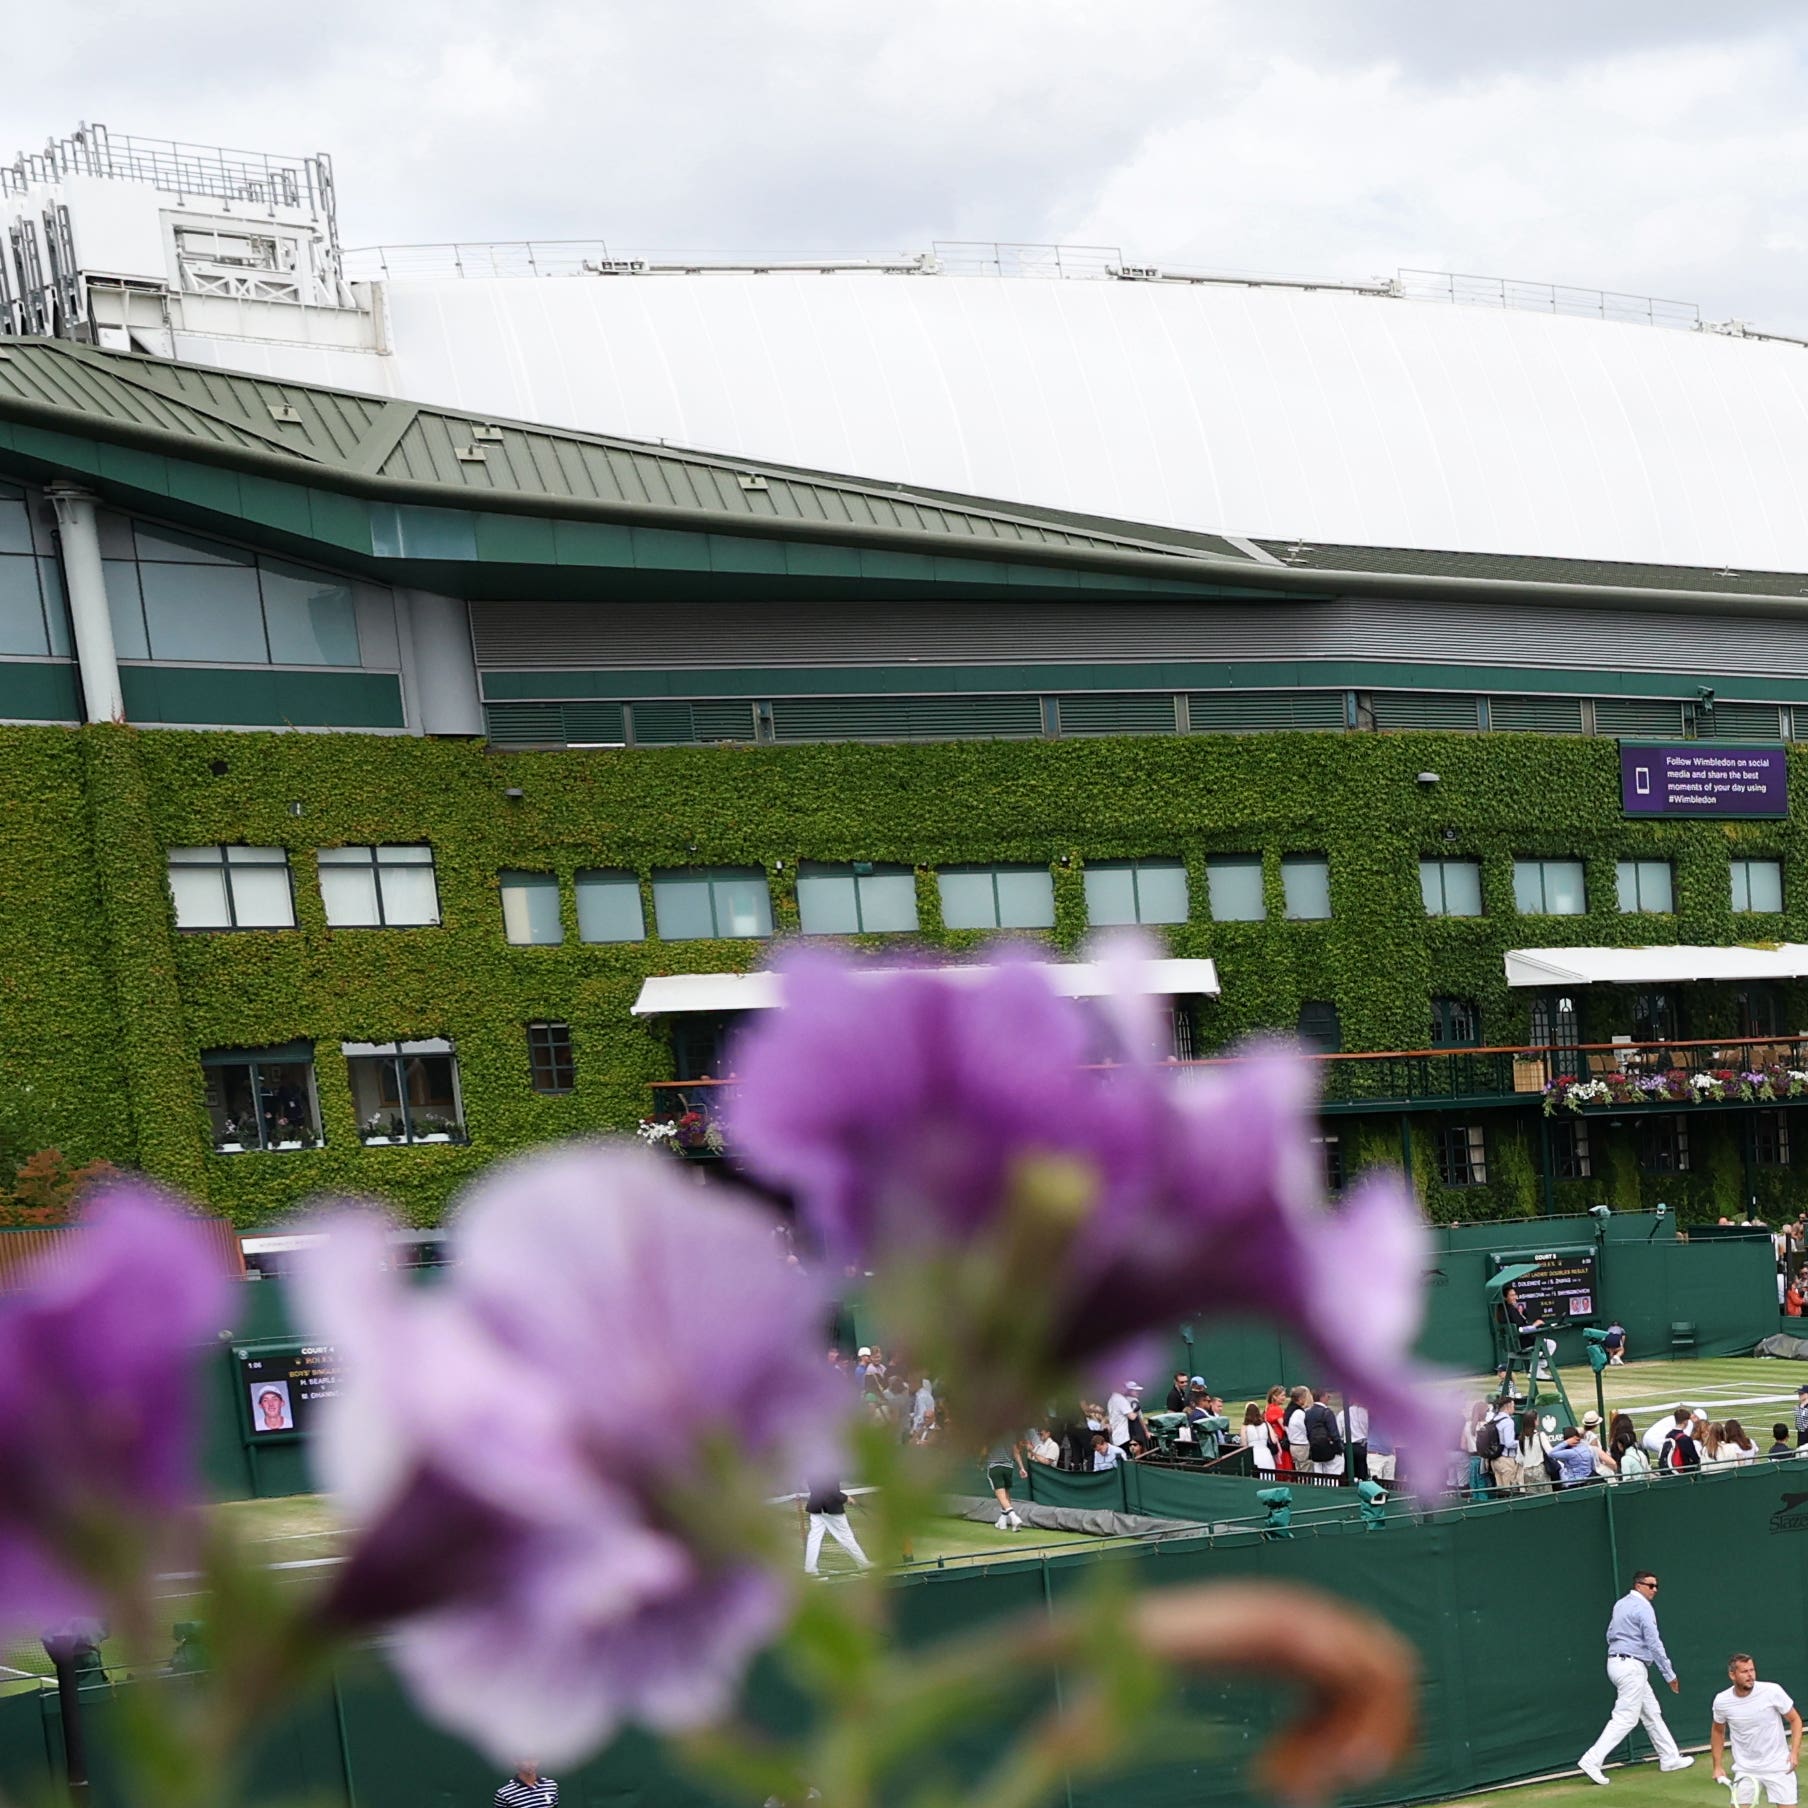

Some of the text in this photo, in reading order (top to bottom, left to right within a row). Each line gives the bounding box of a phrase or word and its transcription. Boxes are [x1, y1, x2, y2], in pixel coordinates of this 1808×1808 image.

[1666, 757, 1691, 766] Follow
[1693, 757, 1736, 767] Wimbledon
[1748, 758, 1770, 767] social
[1667, 770, 1759, 780] media and share the best
[1667, 782, 1767, 794] moments of your day using
[1668, 795, 1717, 804] #Wimbledon
